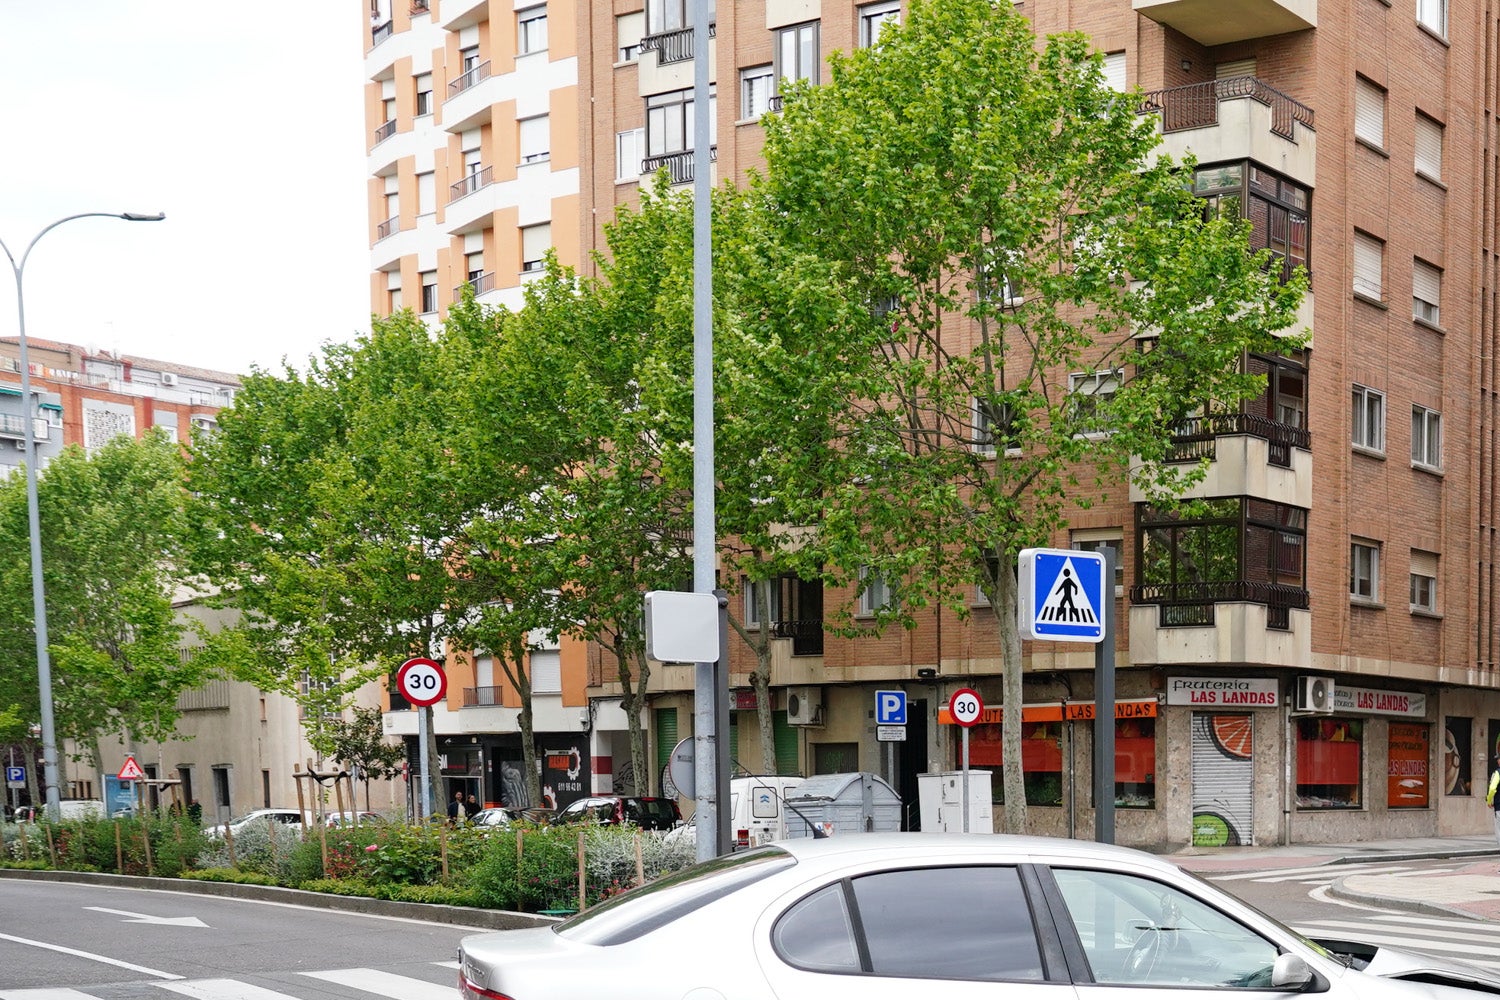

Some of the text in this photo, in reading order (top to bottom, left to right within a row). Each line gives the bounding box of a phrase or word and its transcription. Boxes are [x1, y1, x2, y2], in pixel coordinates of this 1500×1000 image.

[410, 673, 436, 690] 30
[1191, 691, 1275, 704] LAS LANDAS
[1357, 692, 1374, 708] LAS
[1376, 693, 1409, 712] LANDAS
[882, 694, 901, 720] P
[957, 701, 976, 714] 30
[1071, 704, 1092, 719] LAS
[10, 770, 21, 780] P
[1400, 760, 1426, 776] LANDAS
